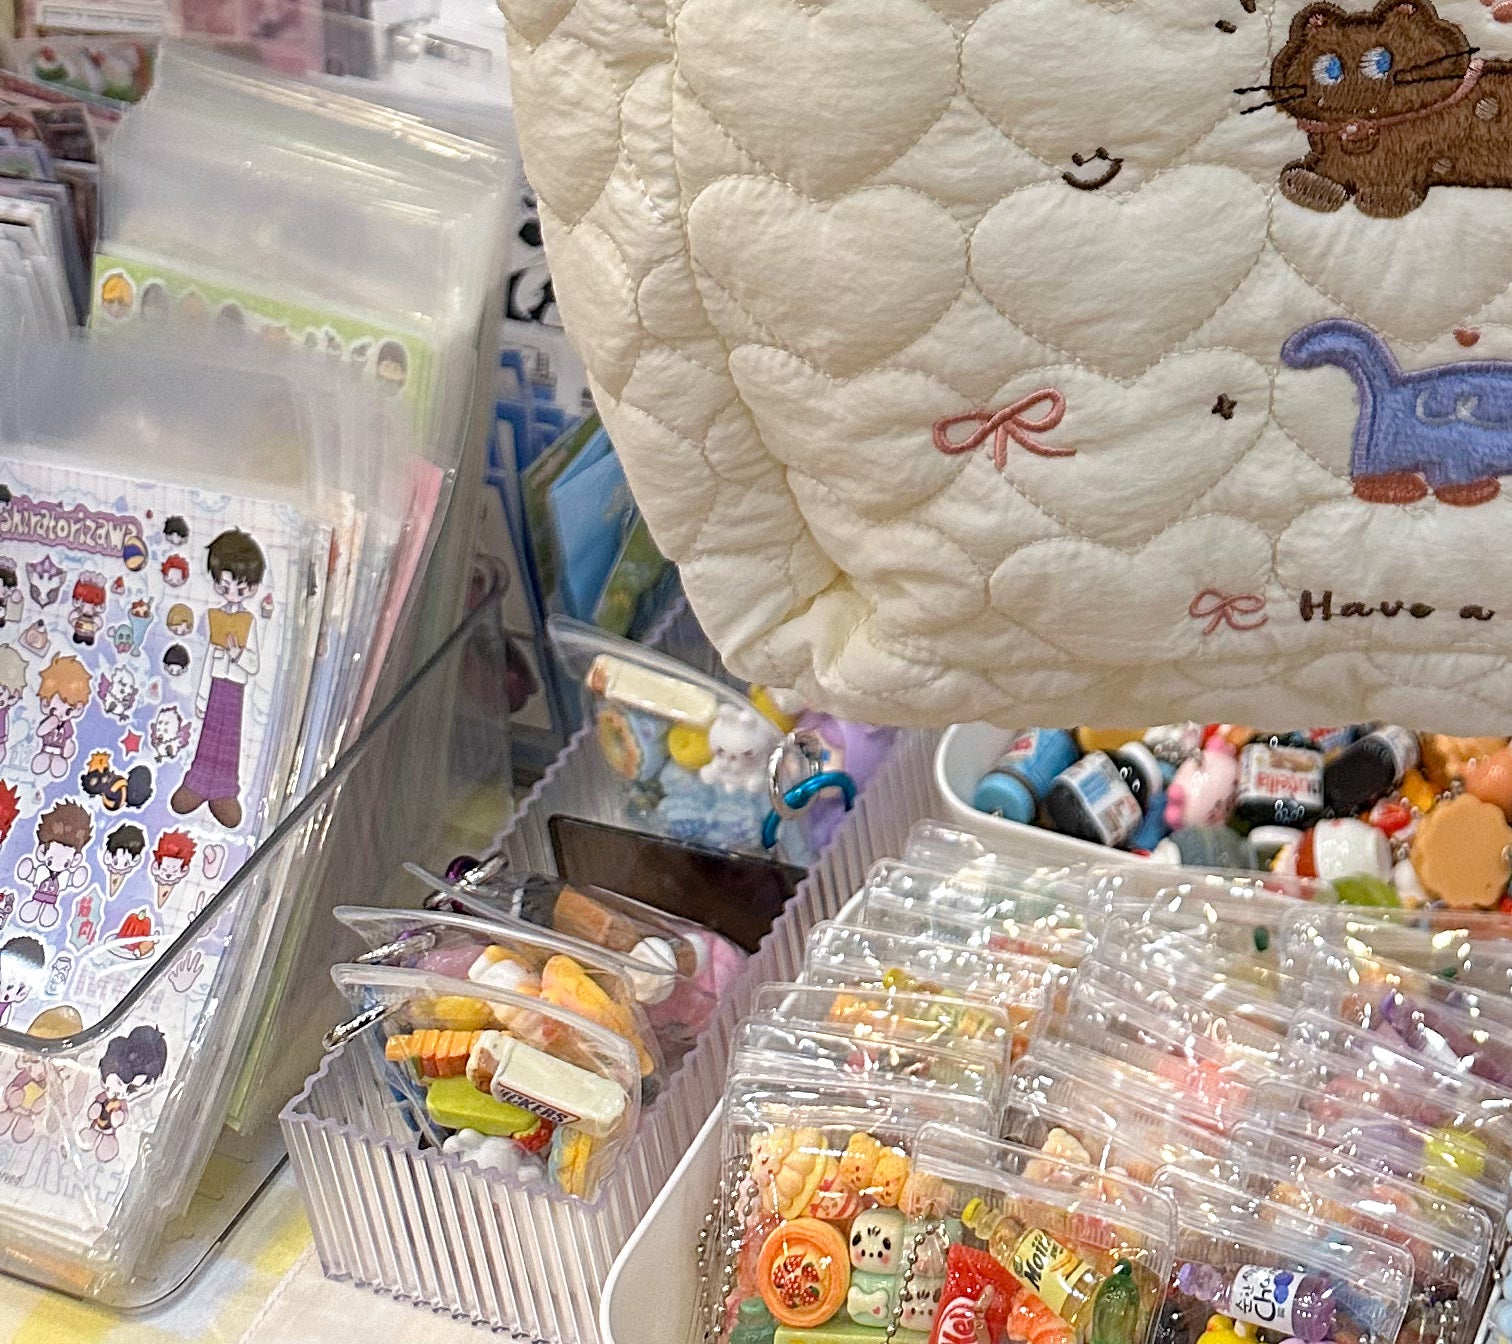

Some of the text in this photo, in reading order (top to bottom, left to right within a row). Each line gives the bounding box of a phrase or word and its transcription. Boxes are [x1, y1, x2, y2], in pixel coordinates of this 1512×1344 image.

[1300, 588, 1436, 622] Have
[1458, 603, 1496, 622] a
[498, 1087, 570, 1124] ICKERS
